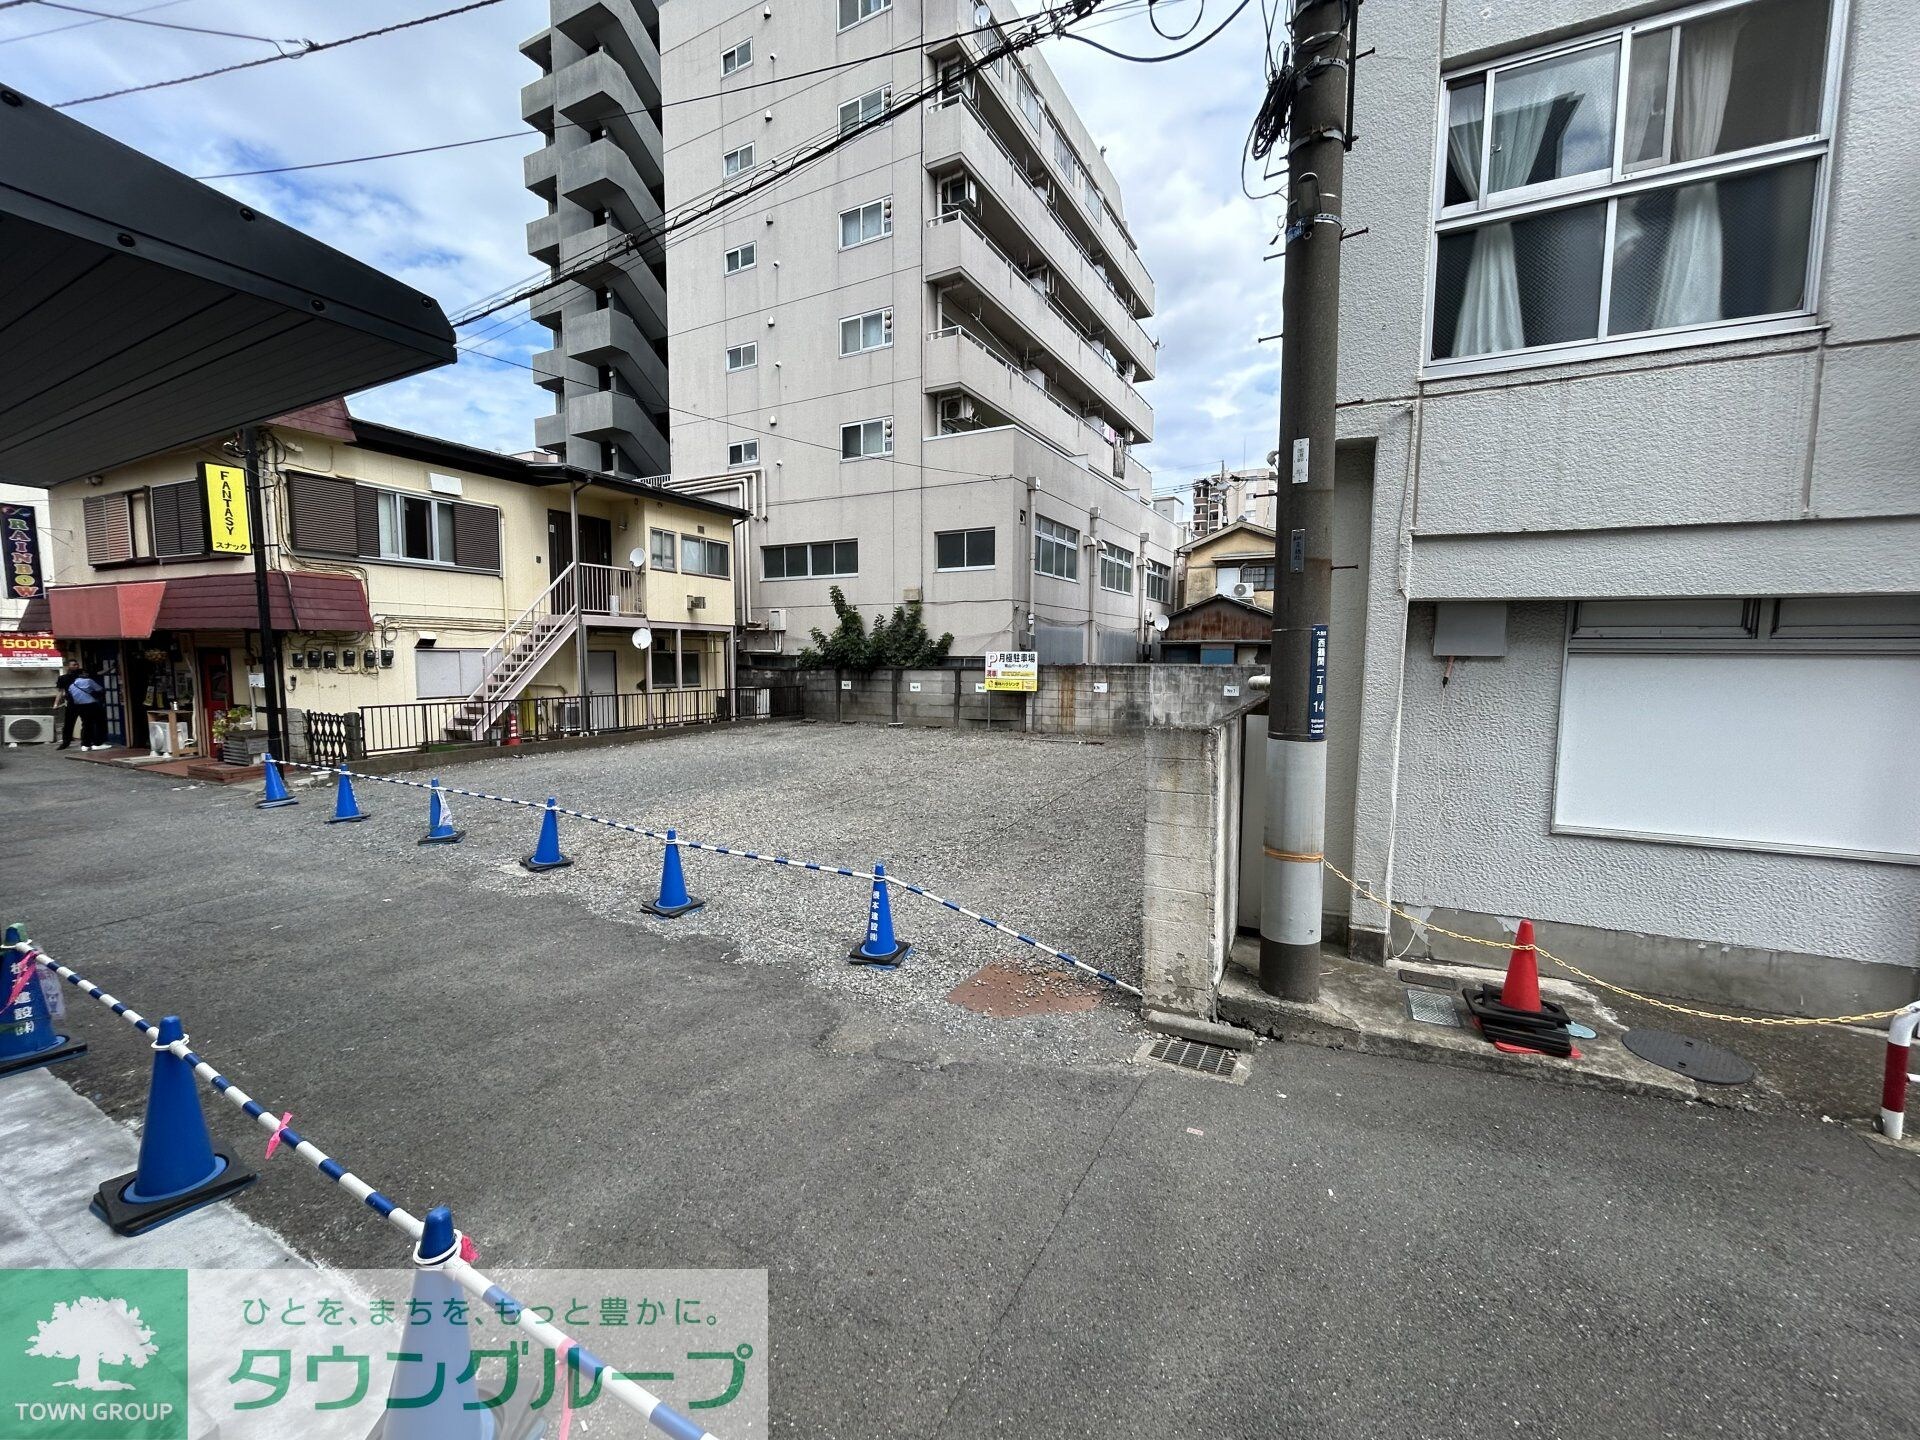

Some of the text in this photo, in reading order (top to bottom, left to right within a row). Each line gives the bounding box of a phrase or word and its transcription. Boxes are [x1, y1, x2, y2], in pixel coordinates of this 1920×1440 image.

[220, 470, 234, 536] FANTASY
[216, 541, 247, 551] スナック
[8, 518, 39, 597] RAINBOW
[987, 653, 997, 667] P
[999, 653, 1035, 662] 月極駐車場
[1313, 700, 1324, 713] 14
